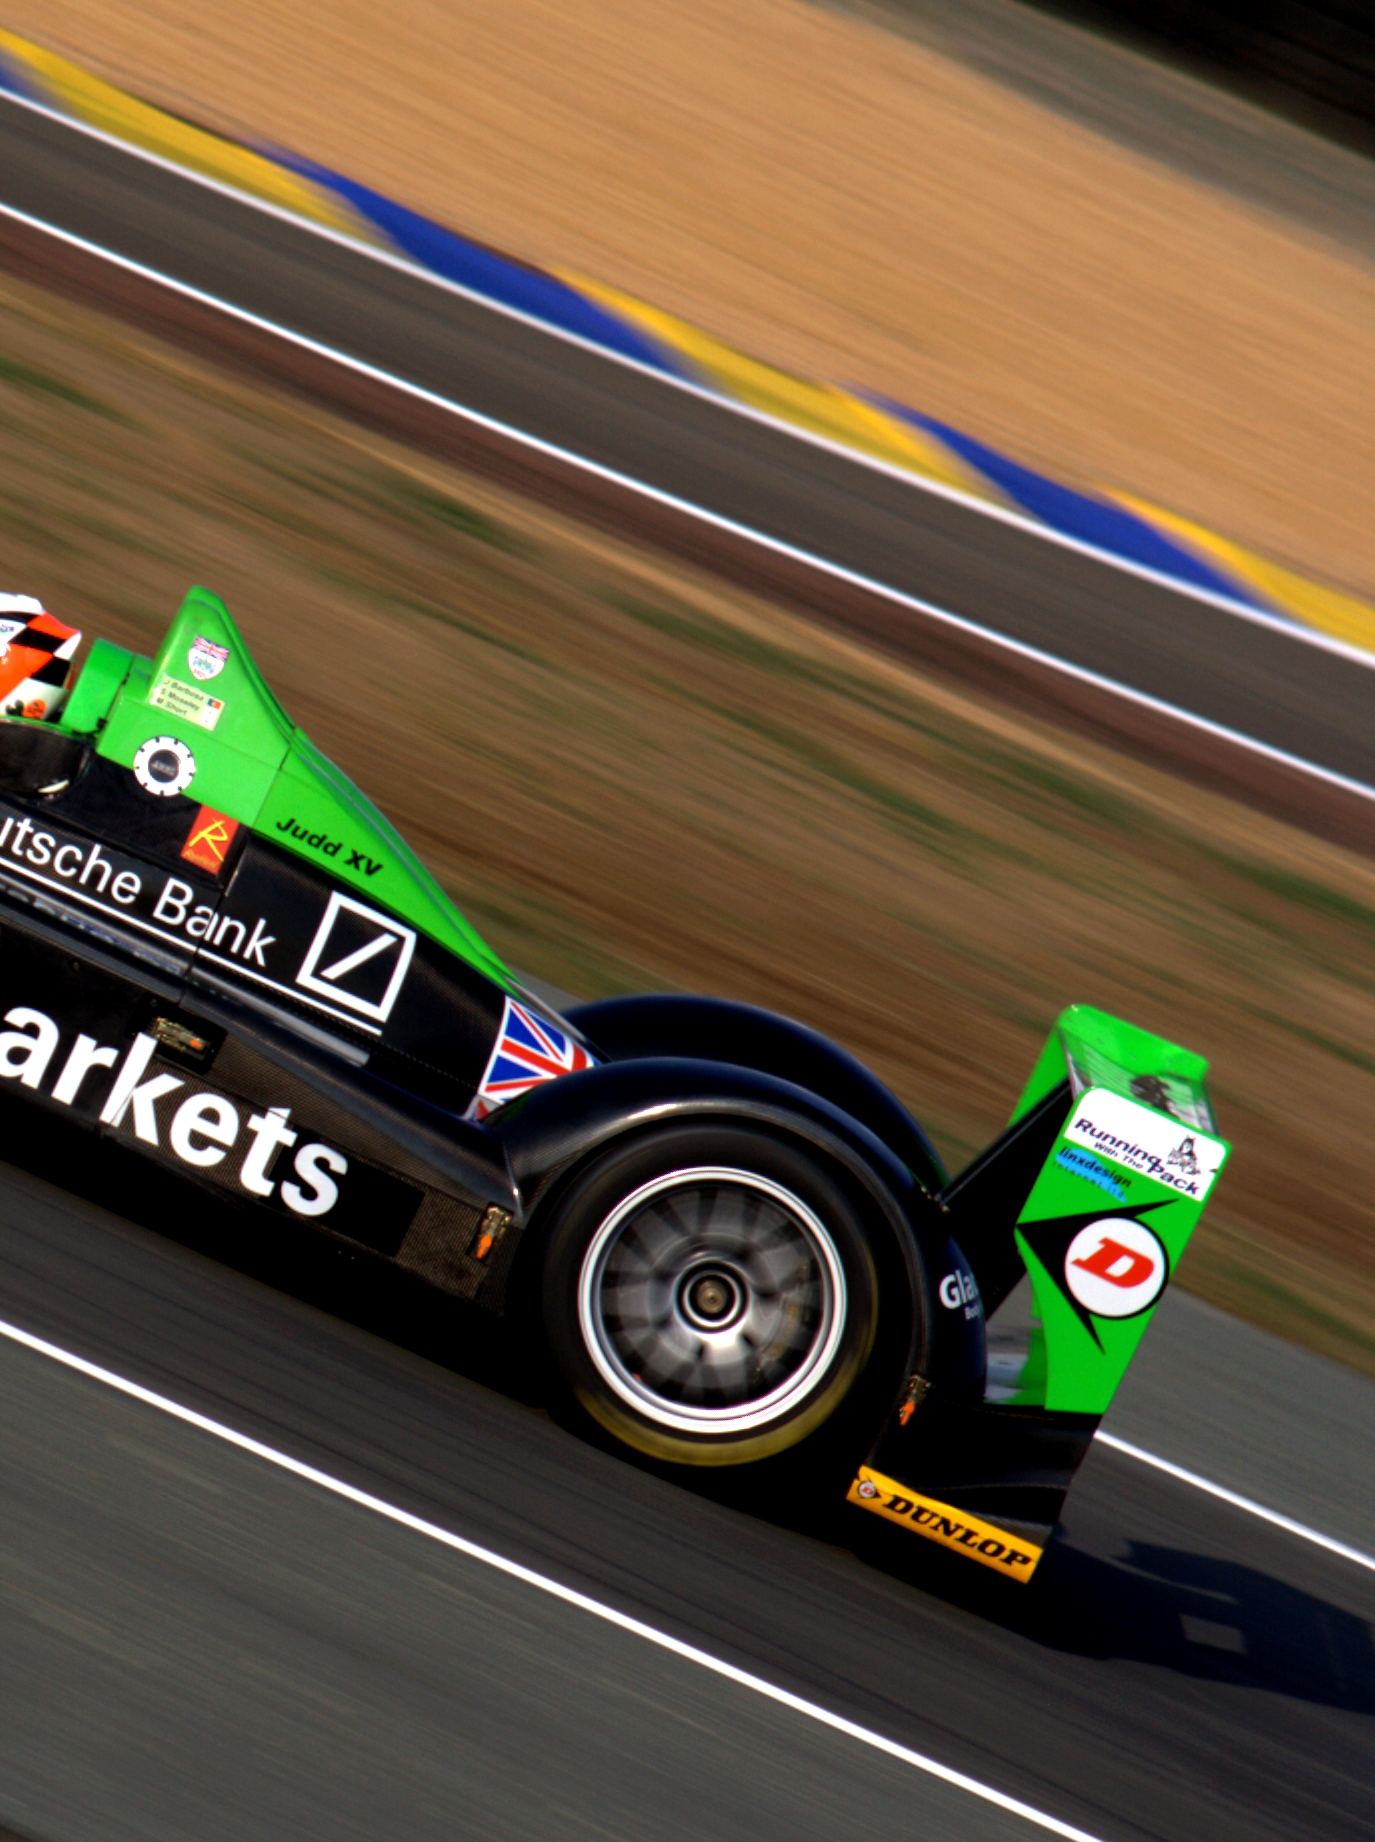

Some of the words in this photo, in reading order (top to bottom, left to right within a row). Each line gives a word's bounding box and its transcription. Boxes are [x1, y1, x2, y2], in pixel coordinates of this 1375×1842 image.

[276, 818, 344, 857] Judd
[344, 849, 384, 876] XV
[152, 877, 277, 968] Bank
[1059, 1146, 1132, 1188] linxdesign
[1074, 1118, 1162, 1172] Running
[1123, 1154, 1144, 1169] The
[1147, 1162, 1200, 1196] Pack
[1071, 1236, 1155, 1289] D
[882, 1494, 1033, 1566] DUNLOP
